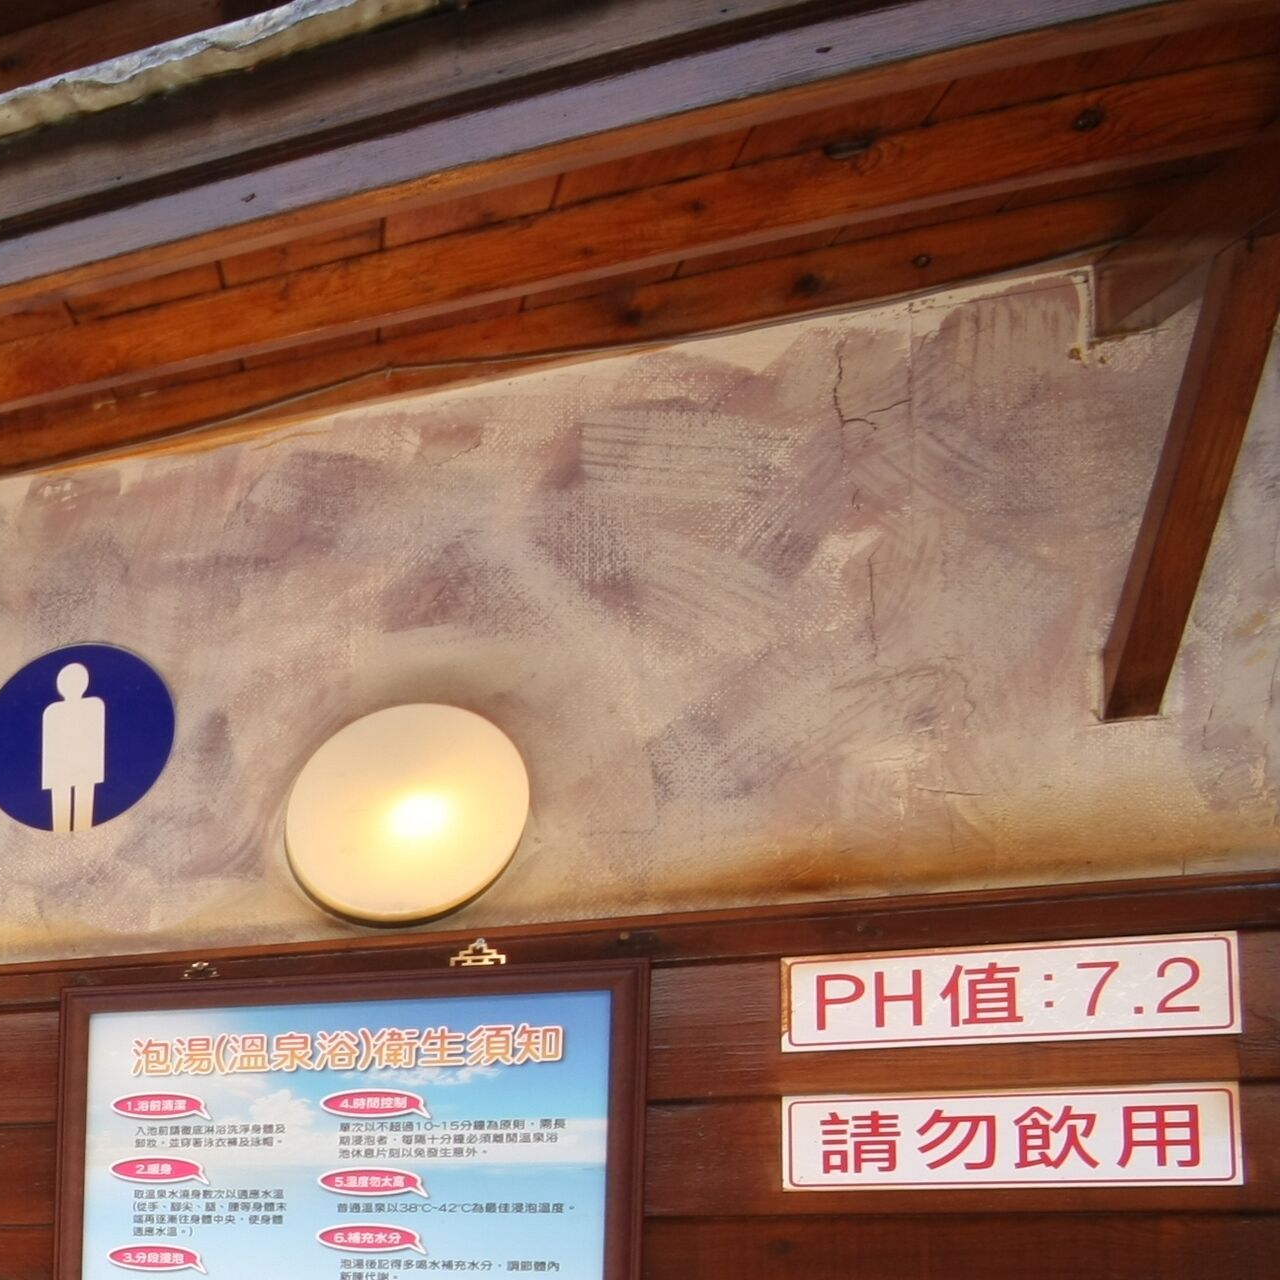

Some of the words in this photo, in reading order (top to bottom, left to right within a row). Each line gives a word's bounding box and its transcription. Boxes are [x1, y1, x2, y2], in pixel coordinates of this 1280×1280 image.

[130, 1024, 564, 1077] 泡湯(溫泉浴)衛生須知
[338, 1097, 408, 1109] 4.時間控制
[819, 1103, 1201, 1175] 請勿飲用
[333, 1232, 402, 1245] 6.補充水分
[123, 1252, 185, 1264] 3.分段浸泡
